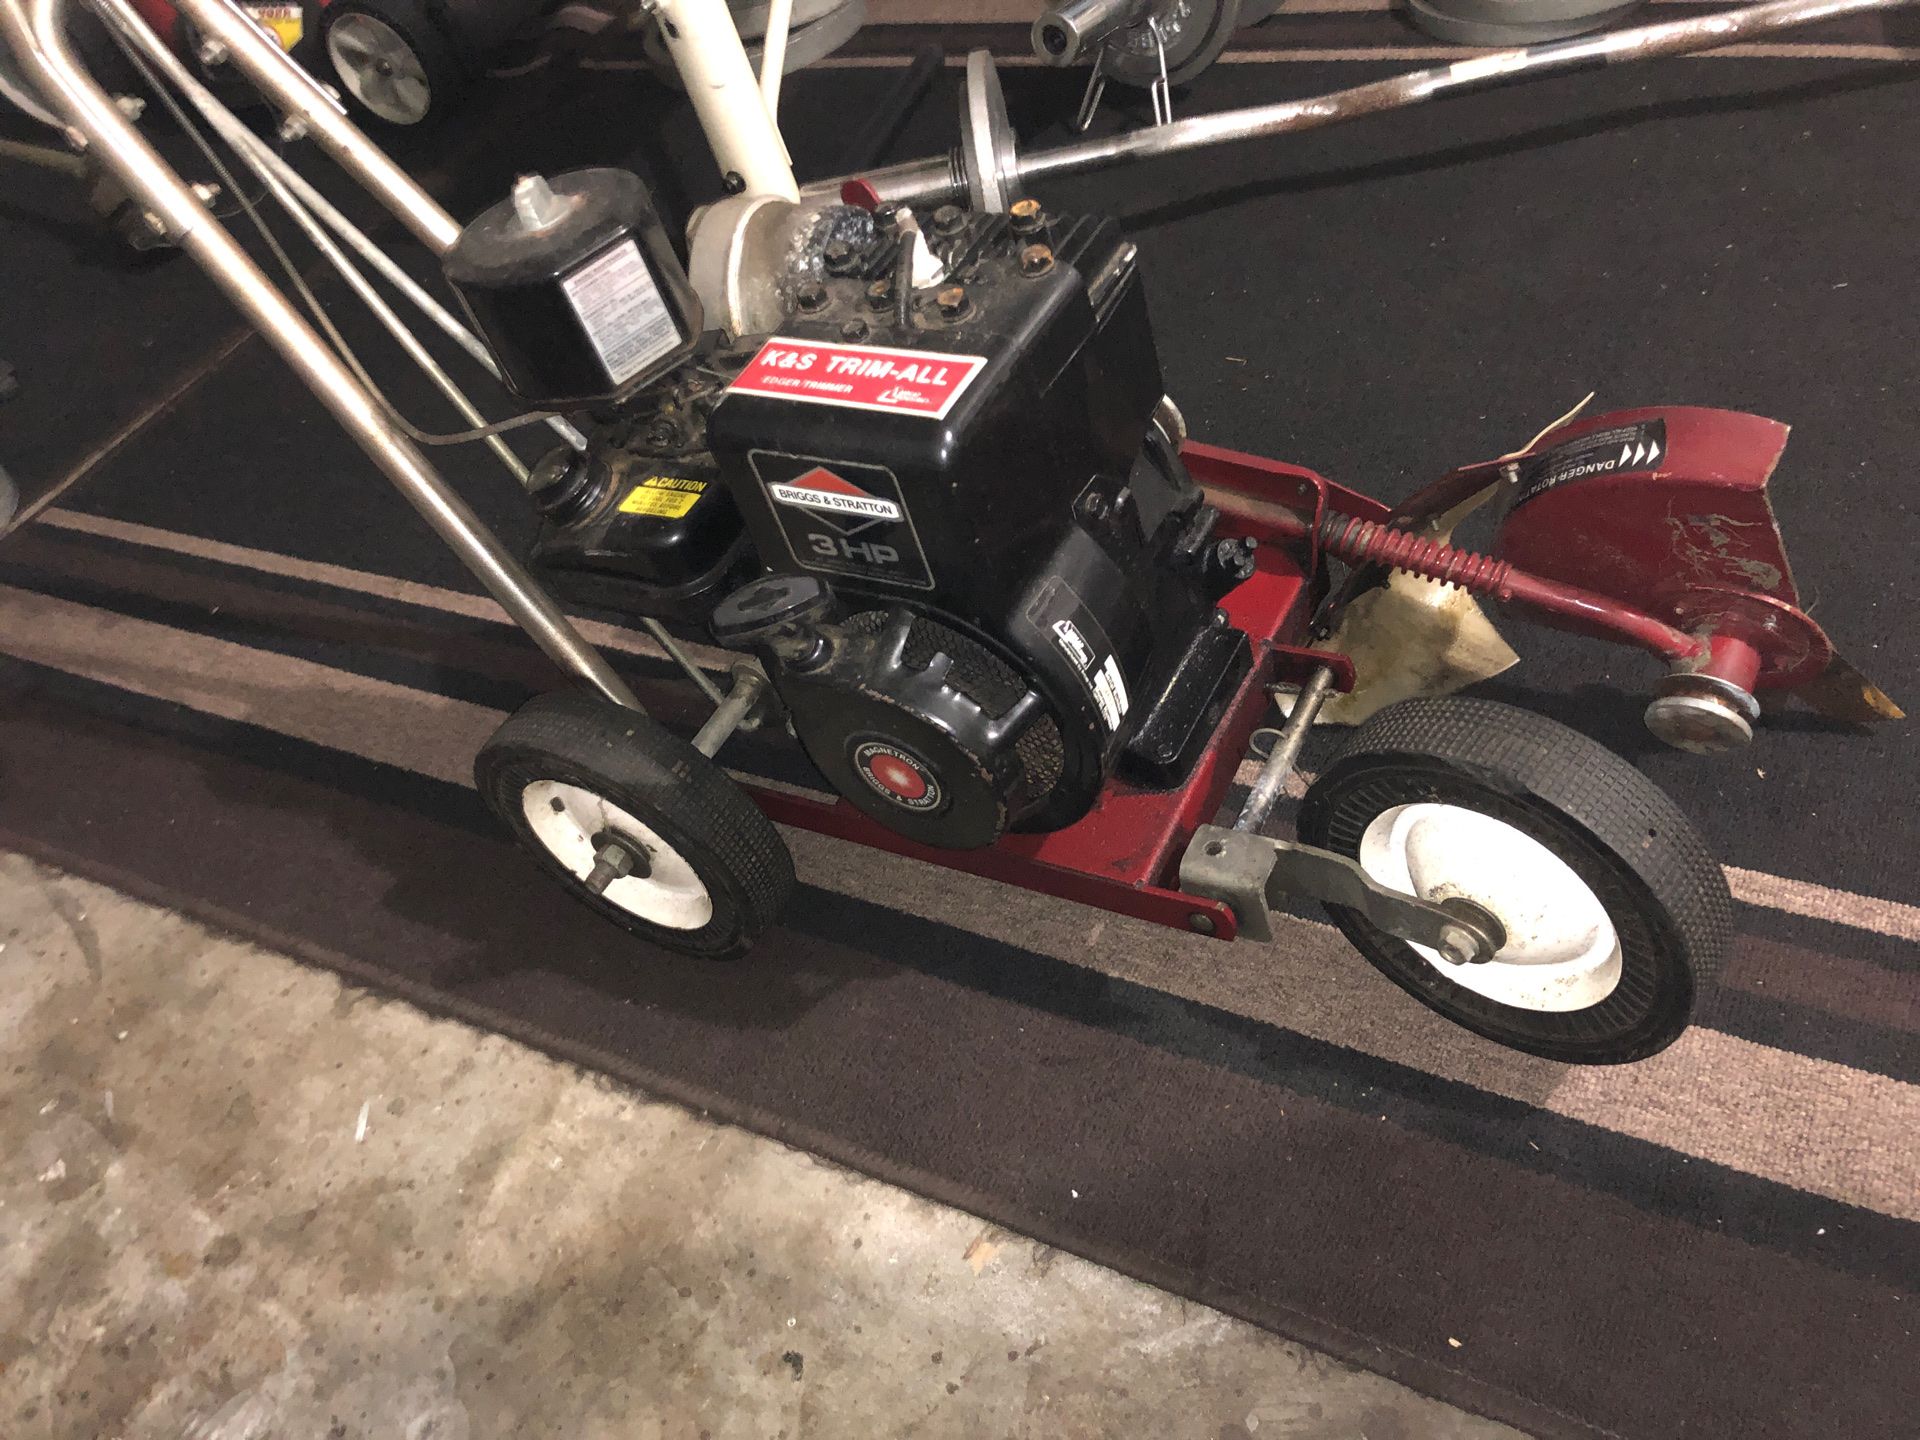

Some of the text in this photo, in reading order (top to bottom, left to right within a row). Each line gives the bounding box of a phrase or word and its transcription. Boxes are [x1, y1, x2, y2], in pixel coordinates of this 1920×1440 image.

[761, 350, 948, 385] K&S TRIM-ALL
[657, 476, 708, 492] CAUTION
[778, 488, 892, 515] BRIGGS & STRATTON
[807, 533, 899, 564] 3 HP
[863, 746, 920, 770] MAGNETRON
